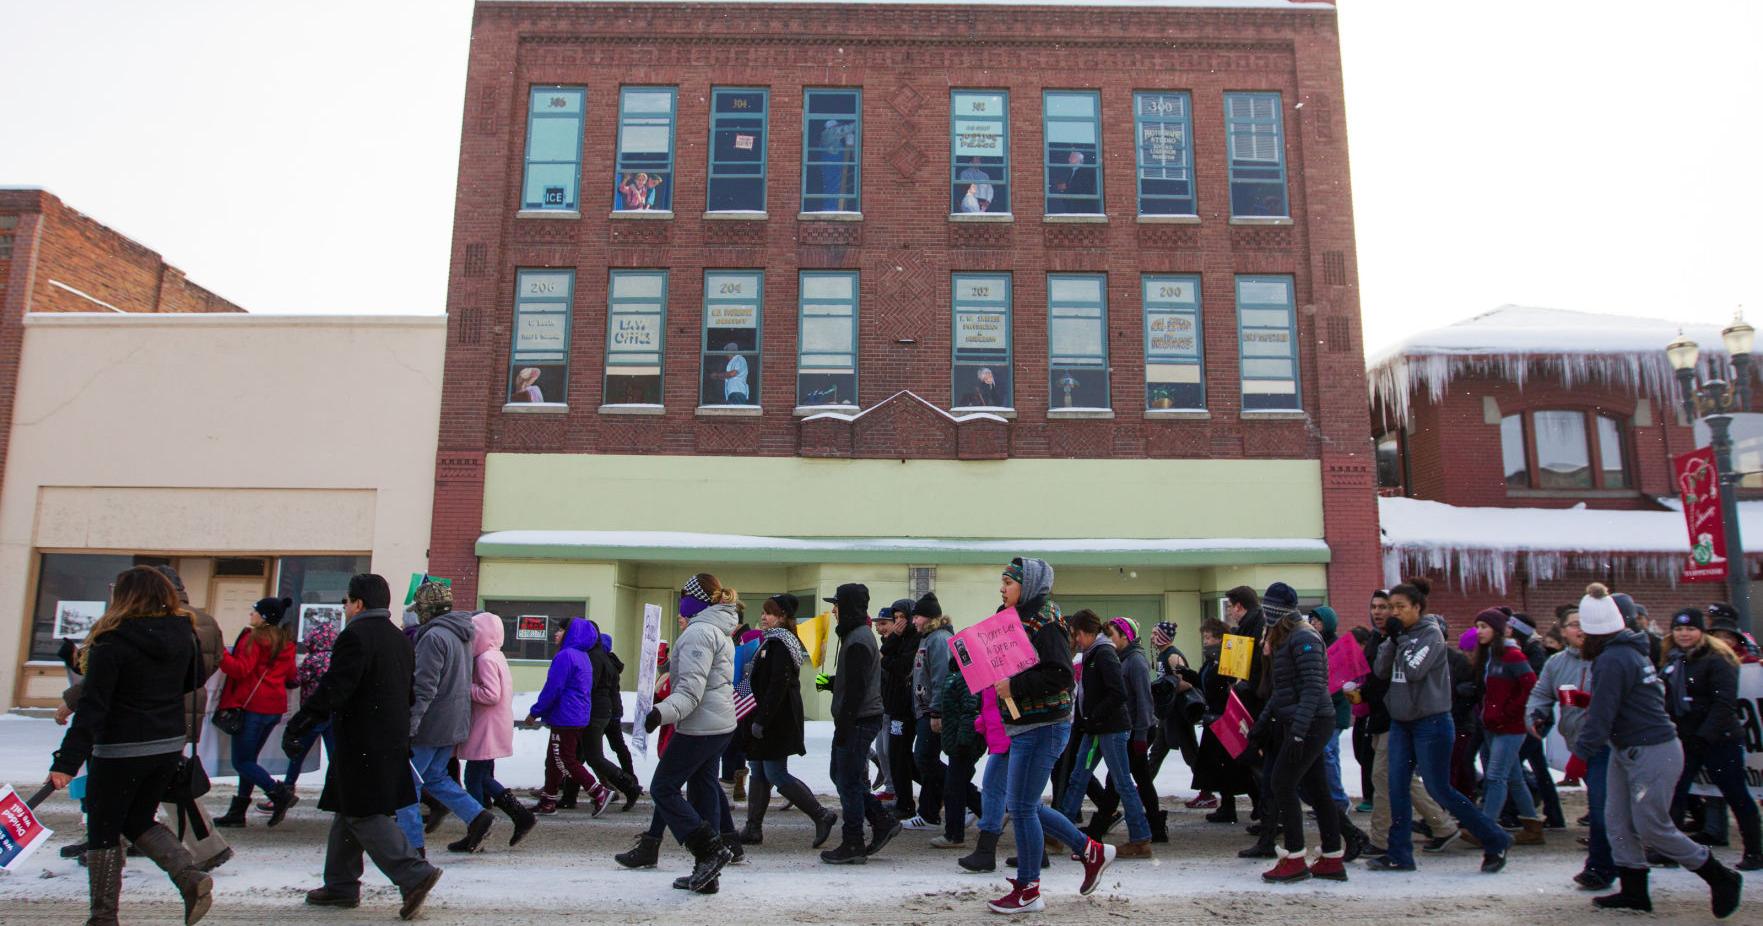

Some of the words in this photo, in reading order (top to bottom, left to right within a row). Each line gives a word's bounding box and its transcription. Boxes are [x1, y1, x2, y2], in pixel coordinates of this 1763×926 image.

[1150, 101, 1173, 112] 300
[546, 192, 563, 202] ICE
[530, 282, 554, 294] 206
[720, 283, 742, 294] 204
[971, 287, 989, 296] 202
[1160, 287, 1182, 297] 200
[10, 803, 26, 818] fall
[1, 809, 27, 837] Divided
